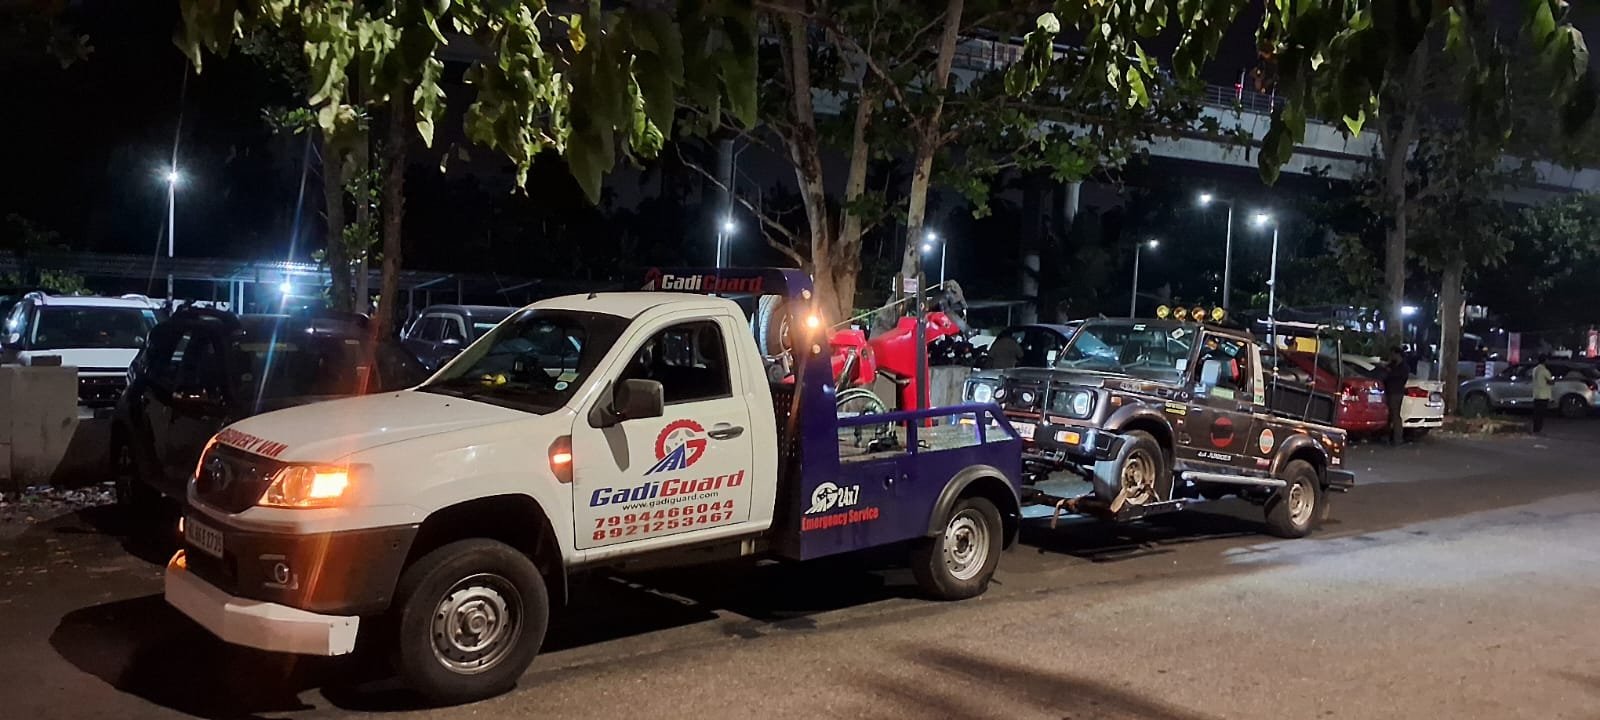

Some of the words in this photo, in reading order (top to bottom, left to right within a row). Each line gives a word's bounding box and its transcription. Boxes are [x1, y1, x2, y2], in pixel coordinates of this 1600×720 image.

[661, 273, 765, 292] GadiGuard
[256, 440, 289, 457] VAN
[589, 469, 745, 507] GadiGuard
[838, 485, 860, 507] 24x7
[622, 490, 719, 511] www.gadiguard.com
[592, 510, 733, 541] 8921253467
[594, 499, 734, 529] 7994466044
[801, 512, 848, 531] Emergency
[848, 506, 879, 523] Service
